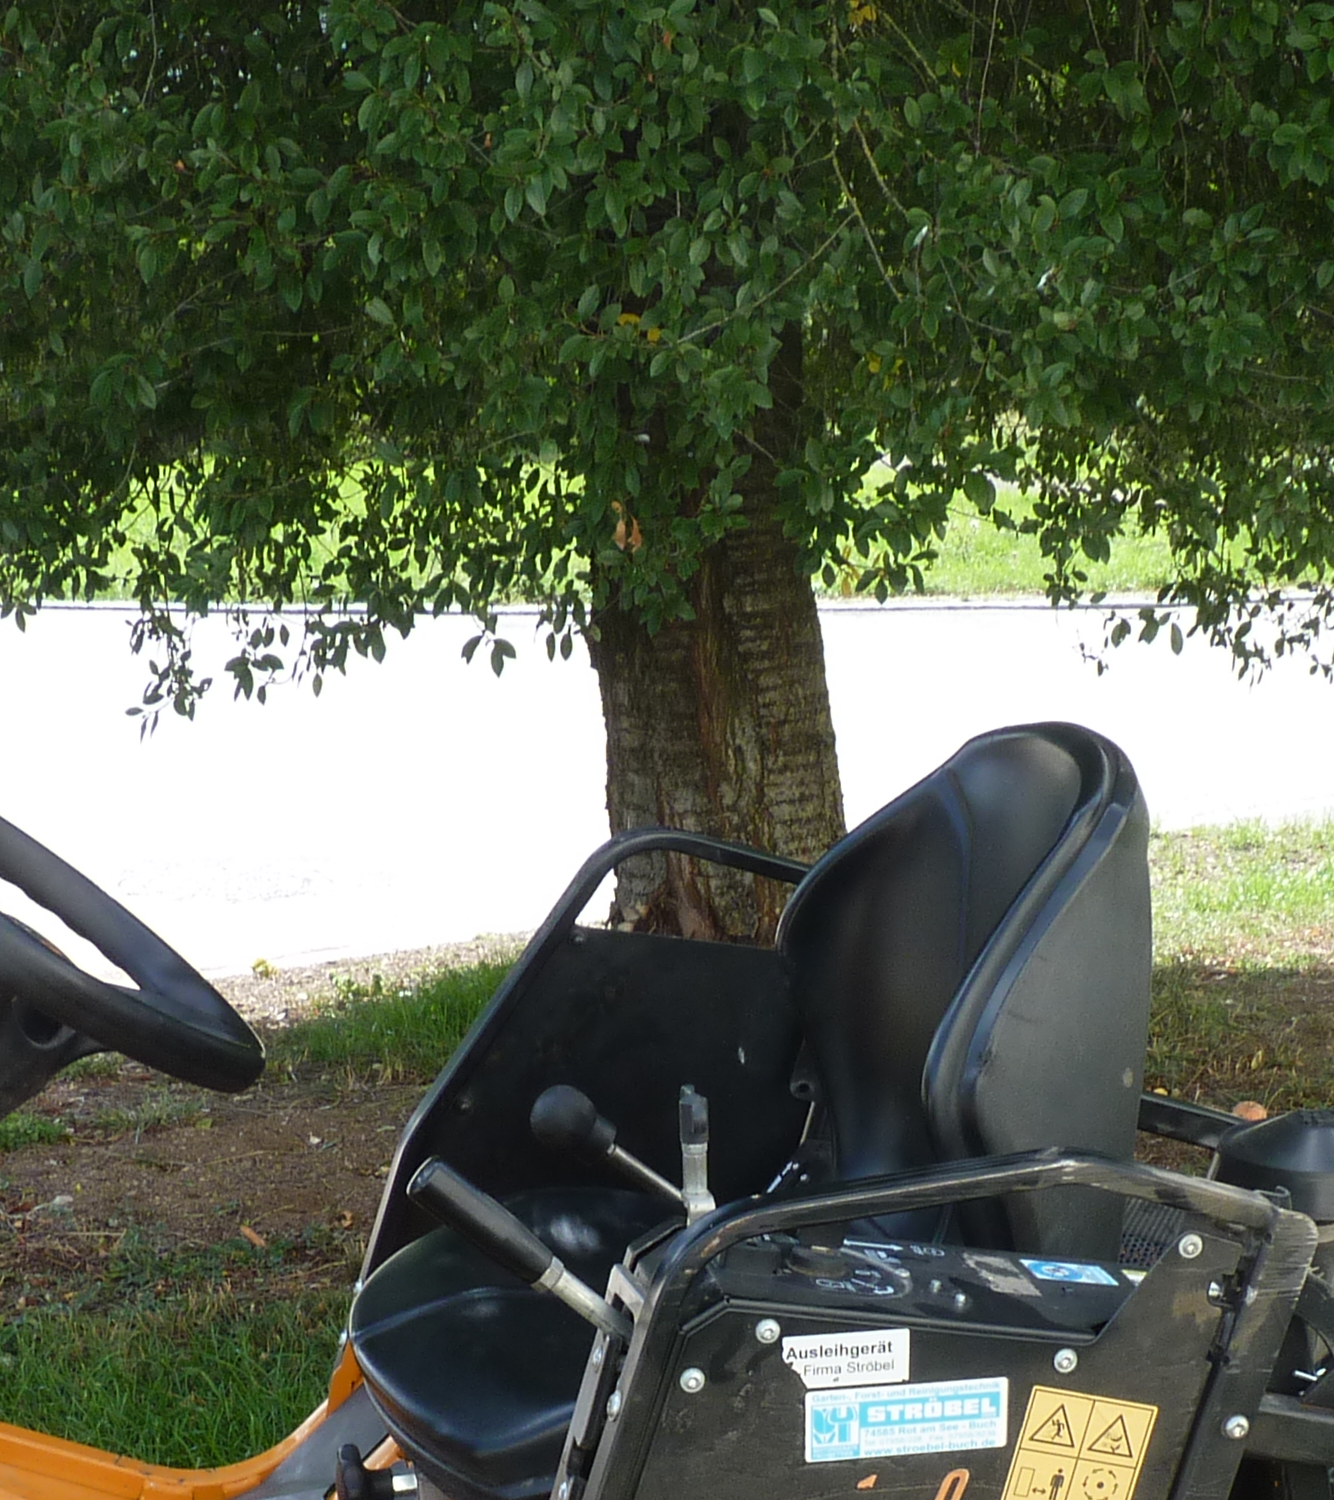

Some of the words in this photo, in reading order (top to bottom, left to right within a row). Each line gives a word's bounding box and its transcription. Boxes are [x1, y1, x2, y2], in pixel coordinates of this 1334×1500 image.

[786, 1340, 893, 1361] Ausleihgerät
[803, 1364, 842, 1377] Firma
[846, 1358, 895, 1374] Ströbel
[887, 1388, 906, 1398] und
[908, 1381, 1001, 1397] Reinigungstechnik
[867, 1396, 998, 1423] STRÖBEL
[898, 1424, 917, 1435] Rot
[920, 1424, 936, 1433] am
[939, 1422, 959, 1432] See
[968, 1419, 997, 1430] Buch
[863, 1438, 997, 1457] www.stroebel-buch.de
